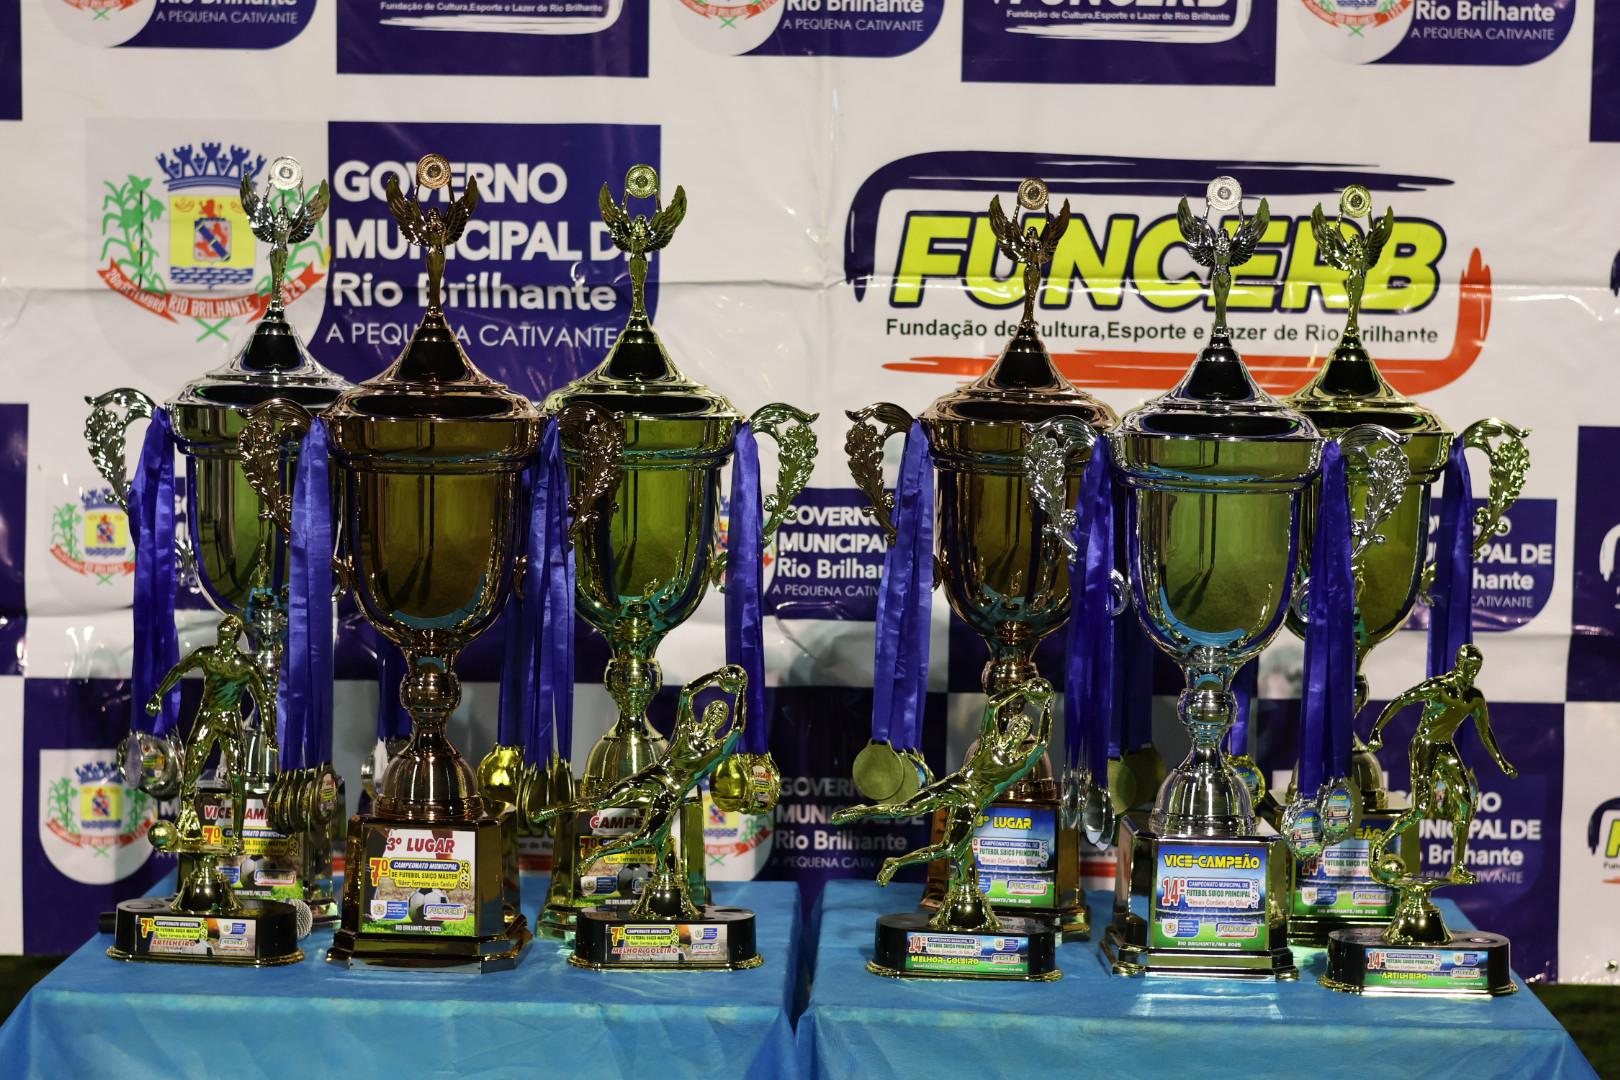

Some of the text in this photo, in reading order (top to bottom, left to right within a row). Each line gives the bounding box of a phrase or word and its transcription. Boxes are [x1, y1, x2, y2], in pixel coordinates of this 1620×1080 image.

[424, 2, 435, 10] de
[512, 4, 535, 12] Lazer
[537, 4, 548, 12] de
[550, 4, 564, 12] Rio
[565, 4, 603, 12] Brilhante
[1416, 0, 1555, 22] Rio Brilhante
[155, 10, 298, 24] A PEQUENA CATIVANTE
[1006, 10, 1048, 20] Fundação
[1050, 10, 1060, 19] de
[1137, 11, 1160, 20] Lazer
[1162, 12, 1173, 20] de
[1174, 12, 1190, 21] Rio
[1191, 12, 1230, 21] Brilhante
[782, 18, 924, 31] A PEQUENA CATIVANTE
[1411, 29, 1555, 41] A PEQUENA CATIVANTE
[335, 218, 582, 261] MUCIPAL
[891, 210, 1447, 315] FUNCERB
[332, 271, 617, 311] Rio Brilhante
[168, 295, 253, 318] RIO BRILHANTE
[325, 323, 618, 349] A PEQUA CATIVANTE
[886, 318, 1439, 344] Fundação de ultura,Esporte e azer de Rio rilhante
[1520, 543, 1553, 565] DE
[777, 558, 811, 579] Rio
[772, 584, 782, 594] A
[784, 585, 842, 597] PEQUENA
[993, 816, 1032, 829] LUGAR
[1511, 820, 1542, 841] DE
[387, 837, 455, 853] 3º LUGAR
[775, 829, 809, 850] Rio
[814, 829, 908, 850] Brilhante
[393, 862, 458, 871] CAMPEONATO MUNICIPAL
[1164, 853, 1260, 869] VICE-CAMPEÃO
[153, 939, 197, 947] ARTILHEIRO
[1382, 972, 1428, 980] ARTILHEIRO
